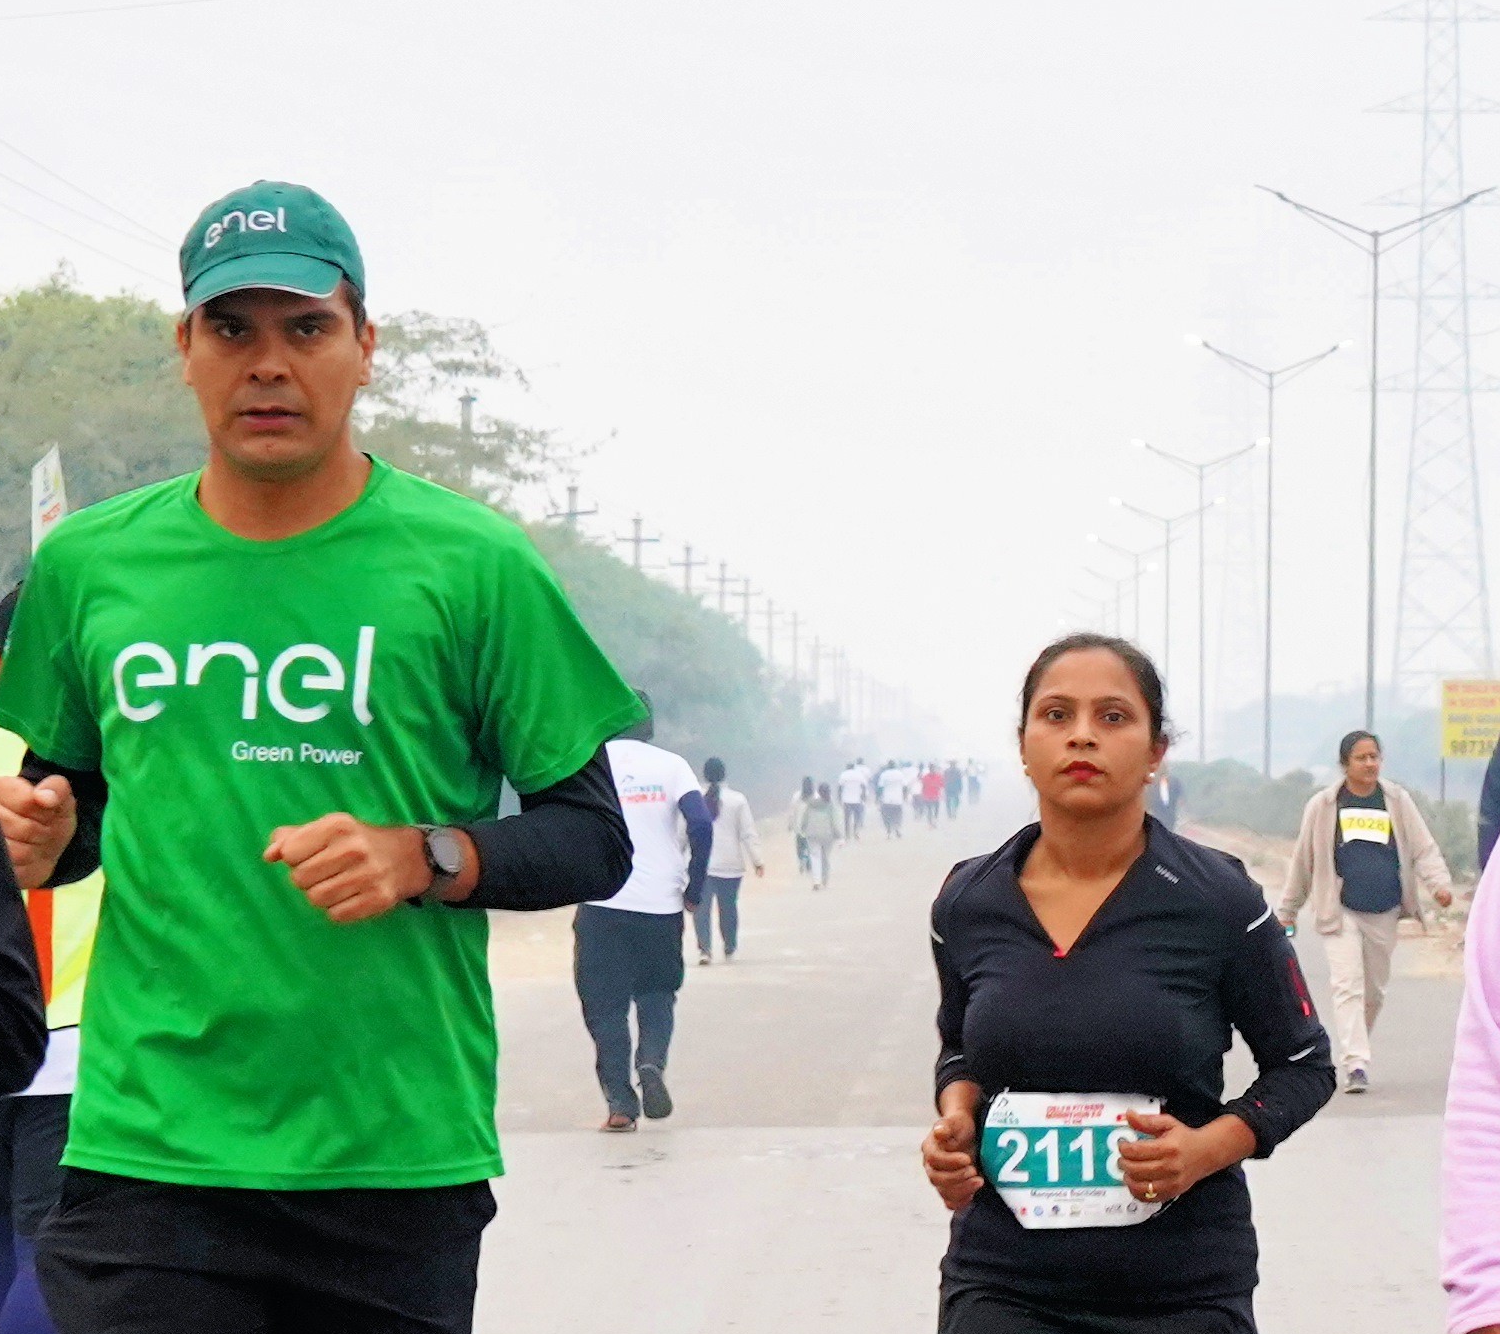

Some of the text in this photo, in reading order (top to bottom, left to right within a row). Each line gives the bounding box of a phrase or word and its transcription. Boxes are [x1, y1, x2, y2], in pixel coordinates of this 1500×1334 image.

[203, 206, 287, 249] enel
[112, 624, 376, 728] enel
[231, 739, 364, 767] Green Power
[996, 1126, 1139, 1183] 2118
